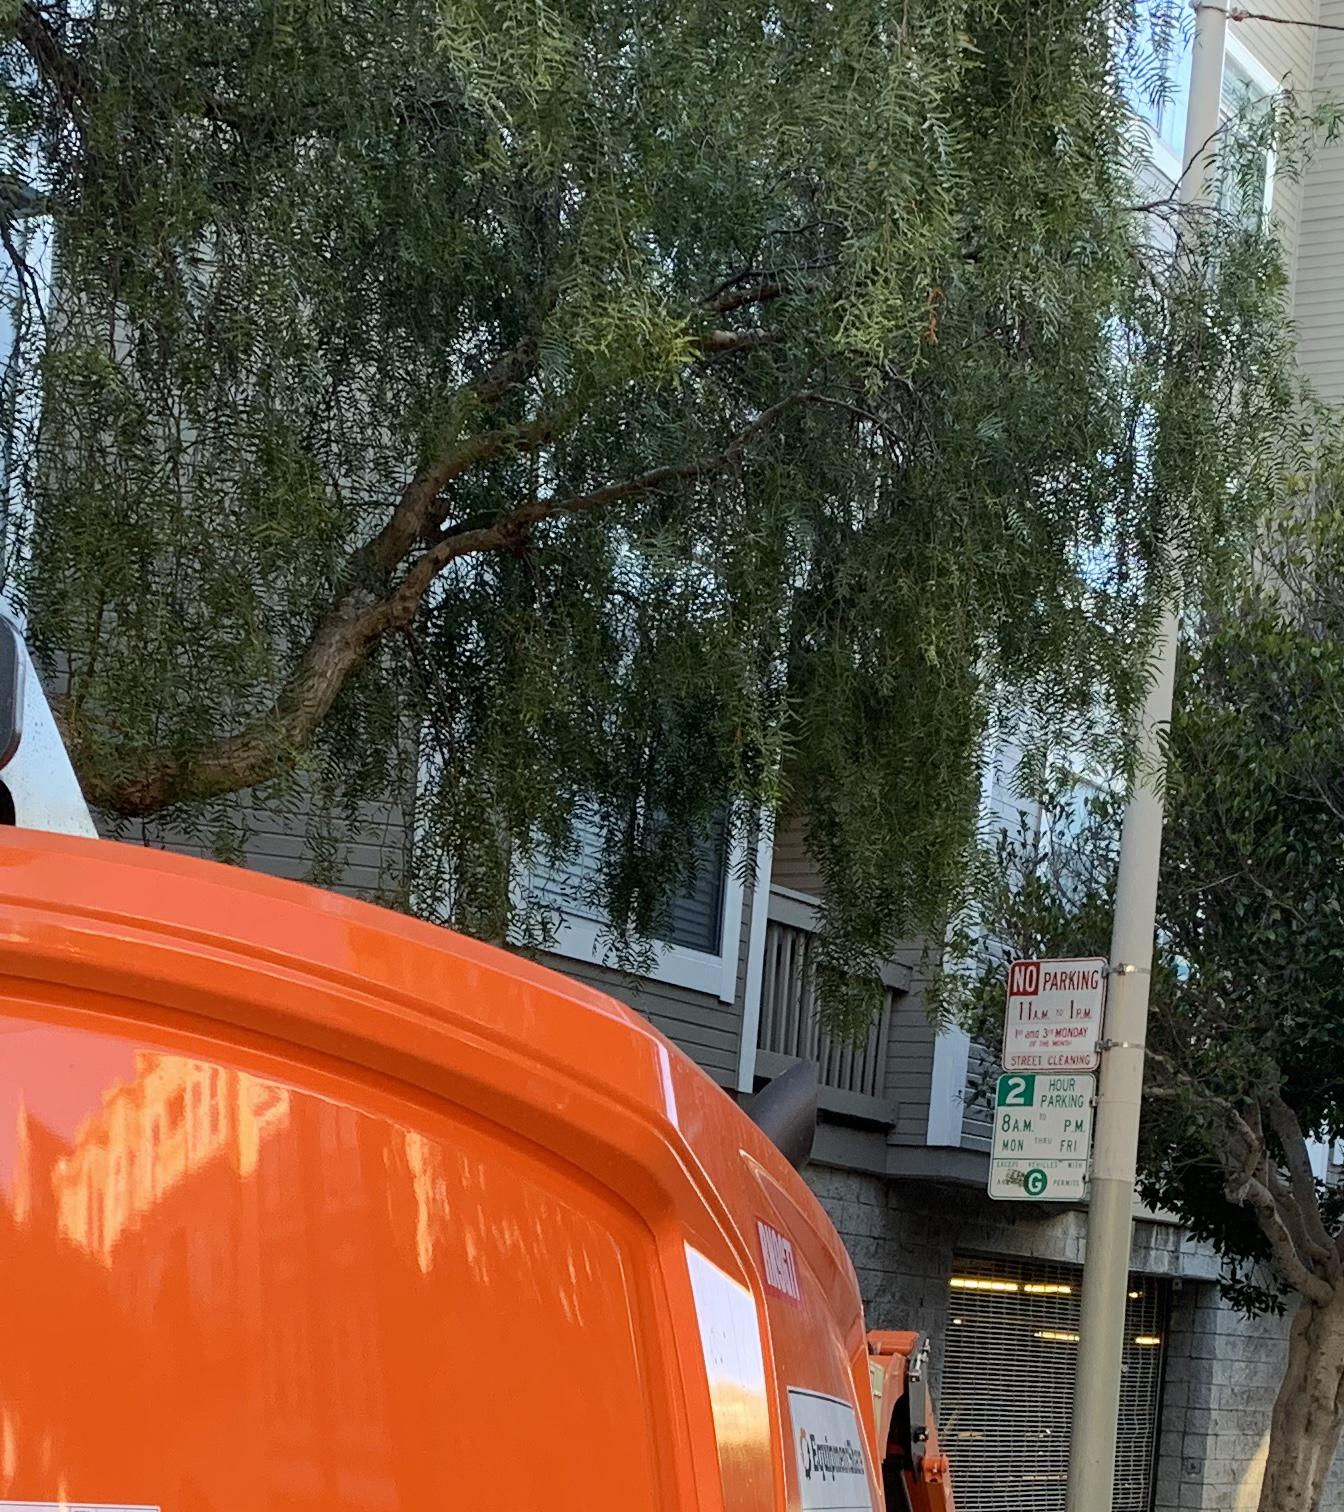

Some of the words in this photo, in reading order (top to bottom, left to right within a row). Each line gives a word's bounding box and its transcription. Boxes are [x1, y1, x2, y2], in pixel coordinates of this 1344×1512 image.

[1012, 965, 1037, 992] NO
[1043, 970, 1099, 991] PARKING
[1055, 1027, 1088, 1038] MONDAY
[1011, 1056, 1042, 1066] STREET
[1048, 1055, 1090, 1065] CLEANING
[1005, 1077, 1026, 1105] 2
[1048, 1078, 1075, 1092] HOUR
[1040, 1095, 1084, 1108] PARKING
[1002, 1139, 1024, 1152] MON
[1060, 1140, 1077, 1152] FRI
[1028, 1172, 1043, 1193] G
